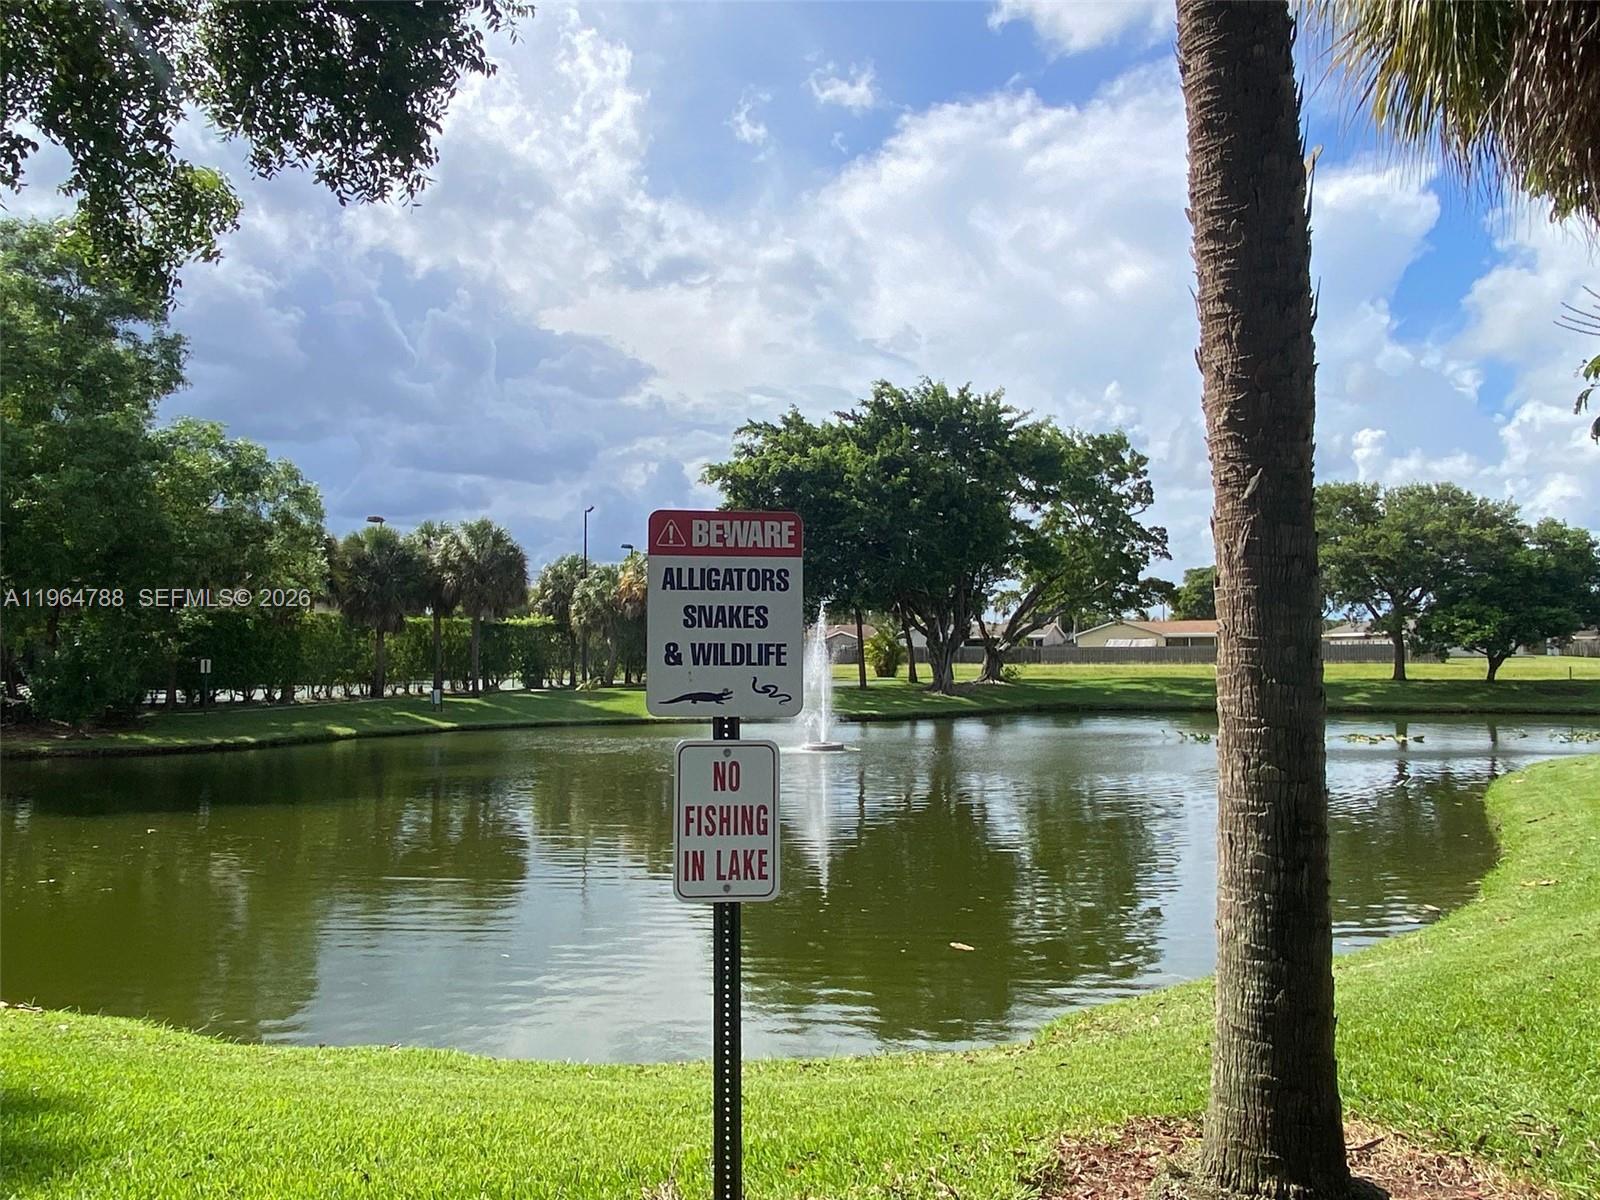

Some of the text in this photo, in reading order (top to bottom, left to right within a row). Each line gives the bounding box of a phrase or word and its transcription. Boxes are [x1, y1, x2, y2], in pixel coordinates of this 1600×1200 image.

[692, 519, 795, 548] BEWARE
[661, 567, 790, 592] ALLIGATORS
[682, 605, 769, 629] SNAKES
[664, 642, 787, 666] & WILDLIFE
[713, 760, 741, 792] NO
[684, 804, 769, 837] FISHING
[683, 849, 769, 881] IN LAKE
